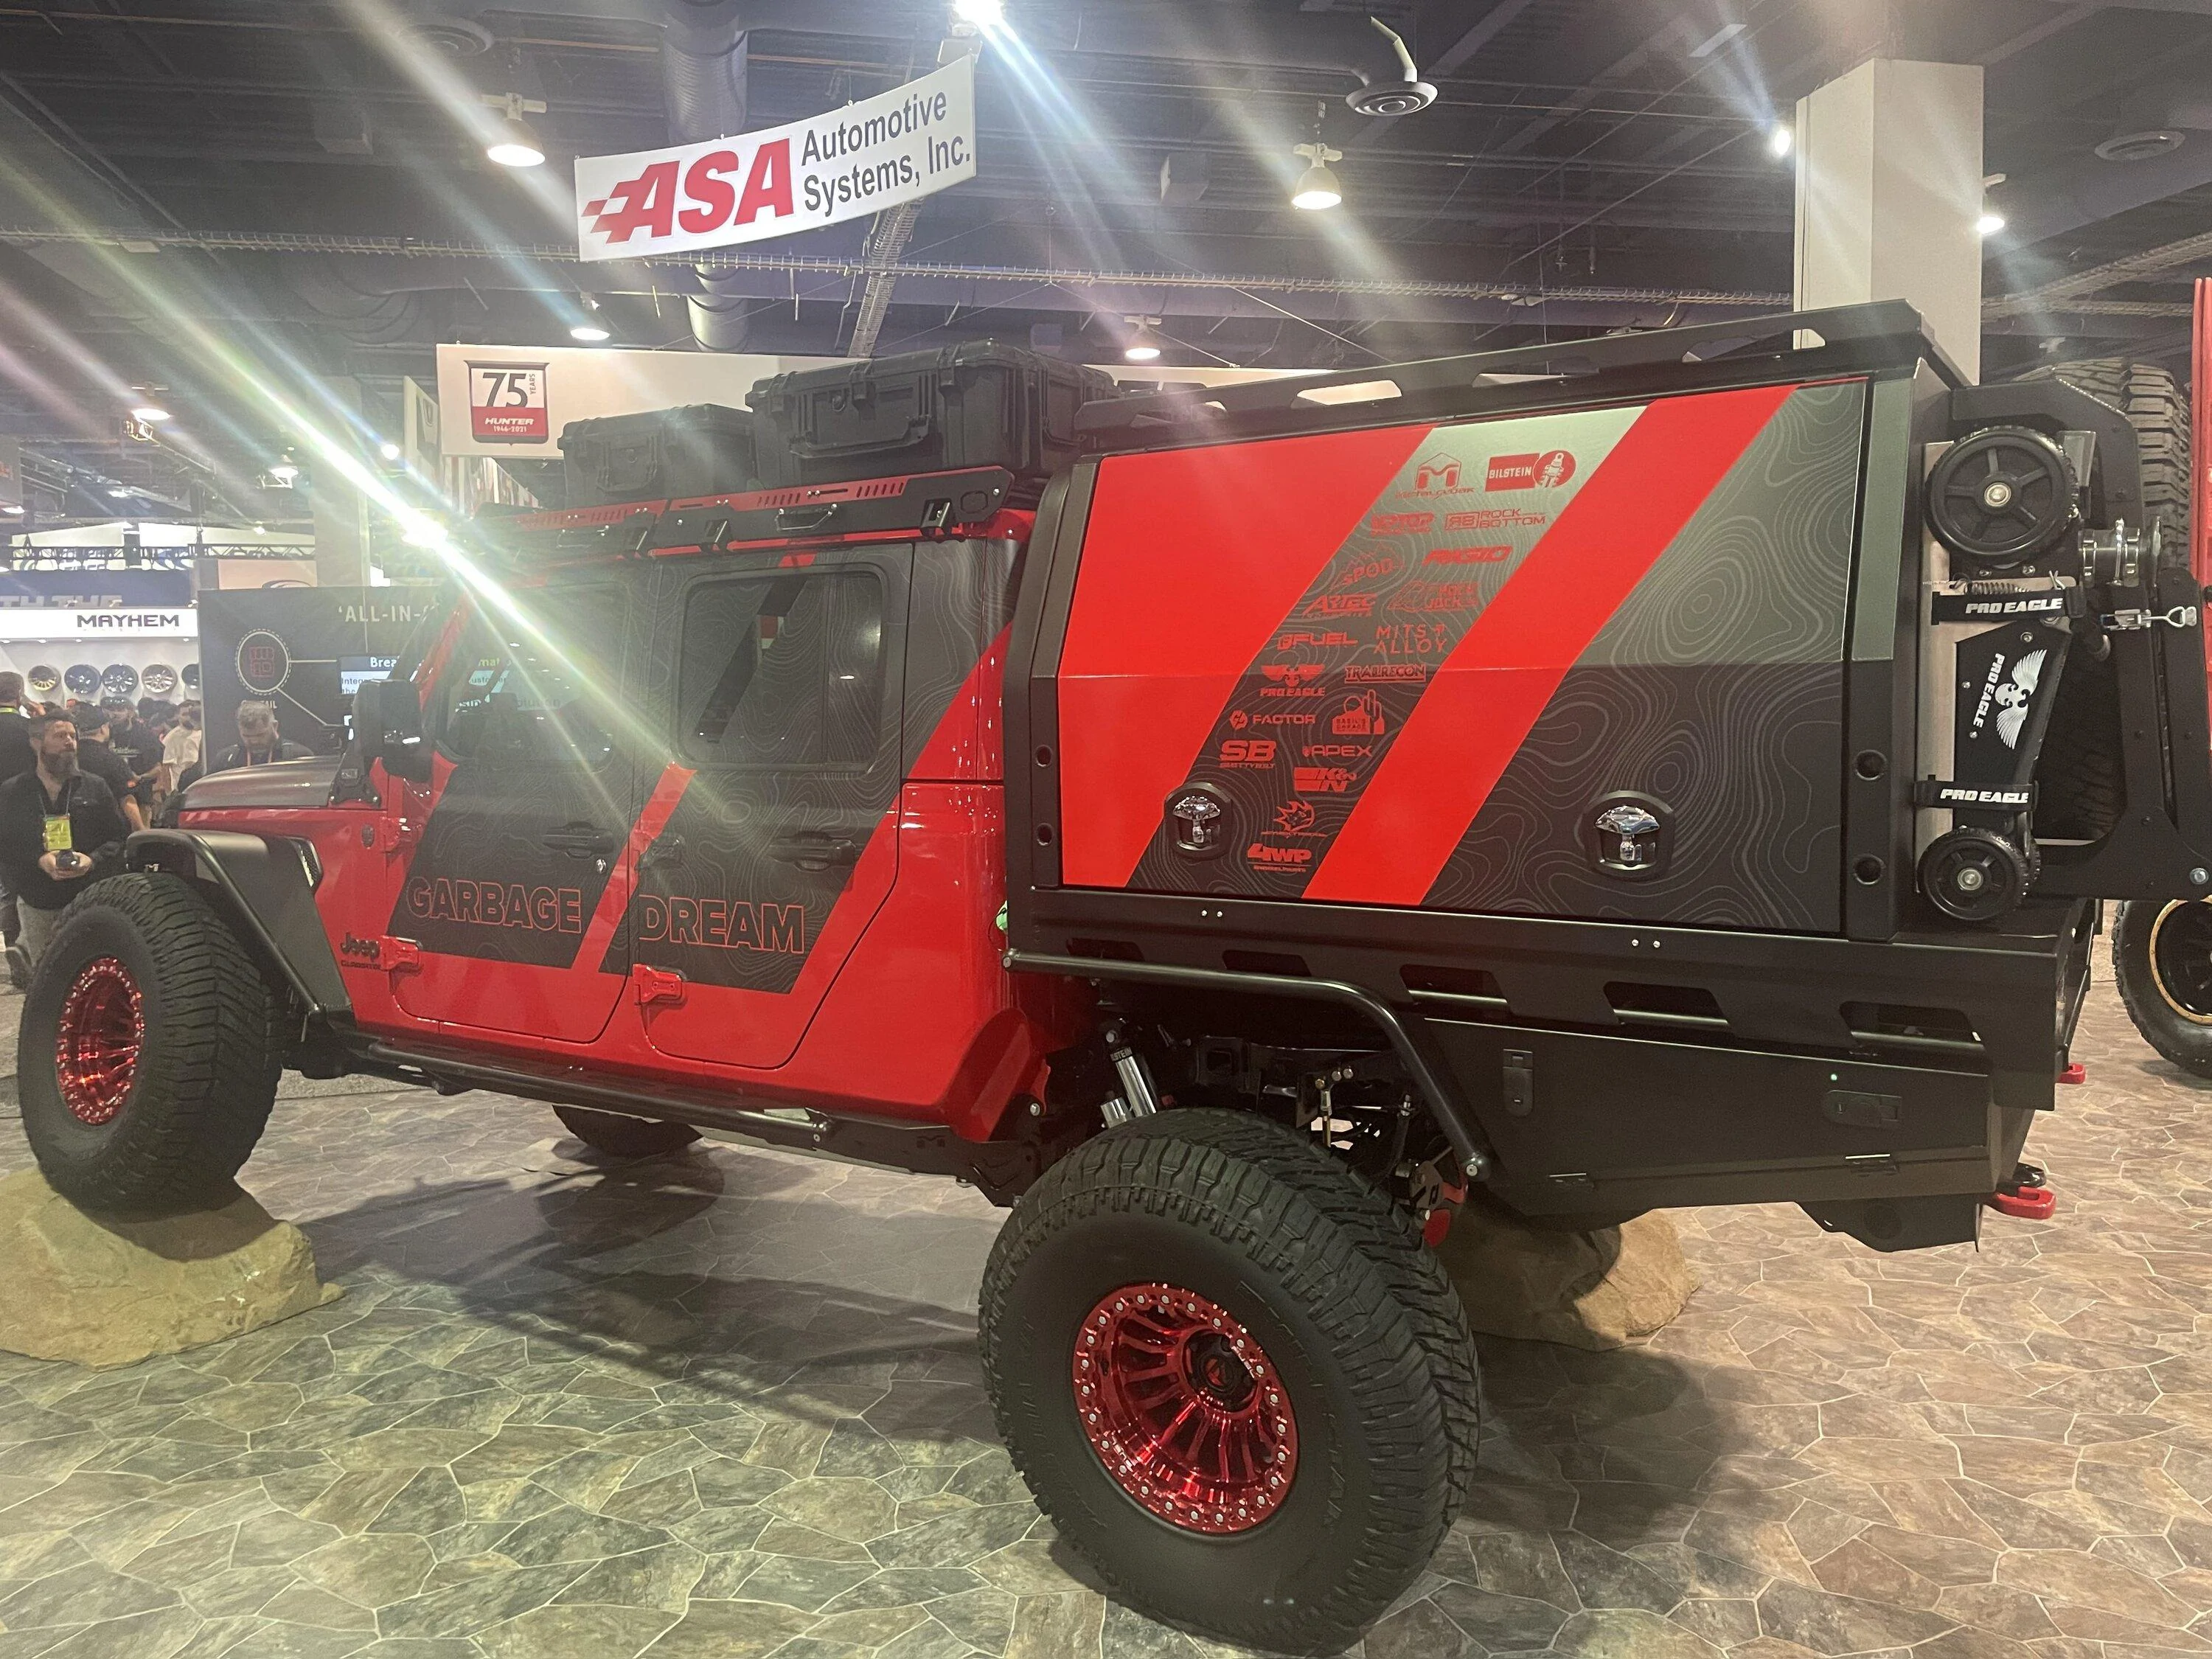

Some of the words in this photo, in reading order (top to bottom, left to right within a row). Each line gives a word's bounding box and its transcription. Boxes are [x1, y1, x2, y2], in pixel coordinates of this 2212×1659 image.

[583, 138, 795, 245] ASA
[801, 91, 947, 167] Automotive
[804, 154, 921, 218] Systems,
[928, 132, 971, 176] Inc.
[482, 372, 528, 408] 75
[529, 373, 537, 395] YEARS
[484, 417, 535, 425] HUNTER
[1488, 466, 1532, 479] BILSTEIN
[1481, 509, 1522, 518] ROCK
[1479, 516, 1546, 529] BOTTOM
[1965, 603, 2003, 613] PRO
[2003, 598, 2063, 613] EAGLE
[77, 614, 180, 627] MAYHEM
[1373, 639, 1447, 654] ALLOY
[1988, 653, 2005, 684] PRO
[1260, 688, 1284, 697] PRO
[1285, 687, 1326, 697] EAGLE
[1973, 683, 1995, 728] EAGLE
[1253, 714, 1316, 725] FACTOR
[1220, 740, 1277, 762] SB
[1311, 745, 1373, 757] APEX
[1940, 788, 1978, 801] PRO
[1978, 790, 2029, 804] EAGLE
[1247, 843, 1312, 863] 4WP
[406, 877, 582, 934] GARBAGE
[637, 894, 805, 954] DREAM
[340, 931, 381, 963] Jeep
